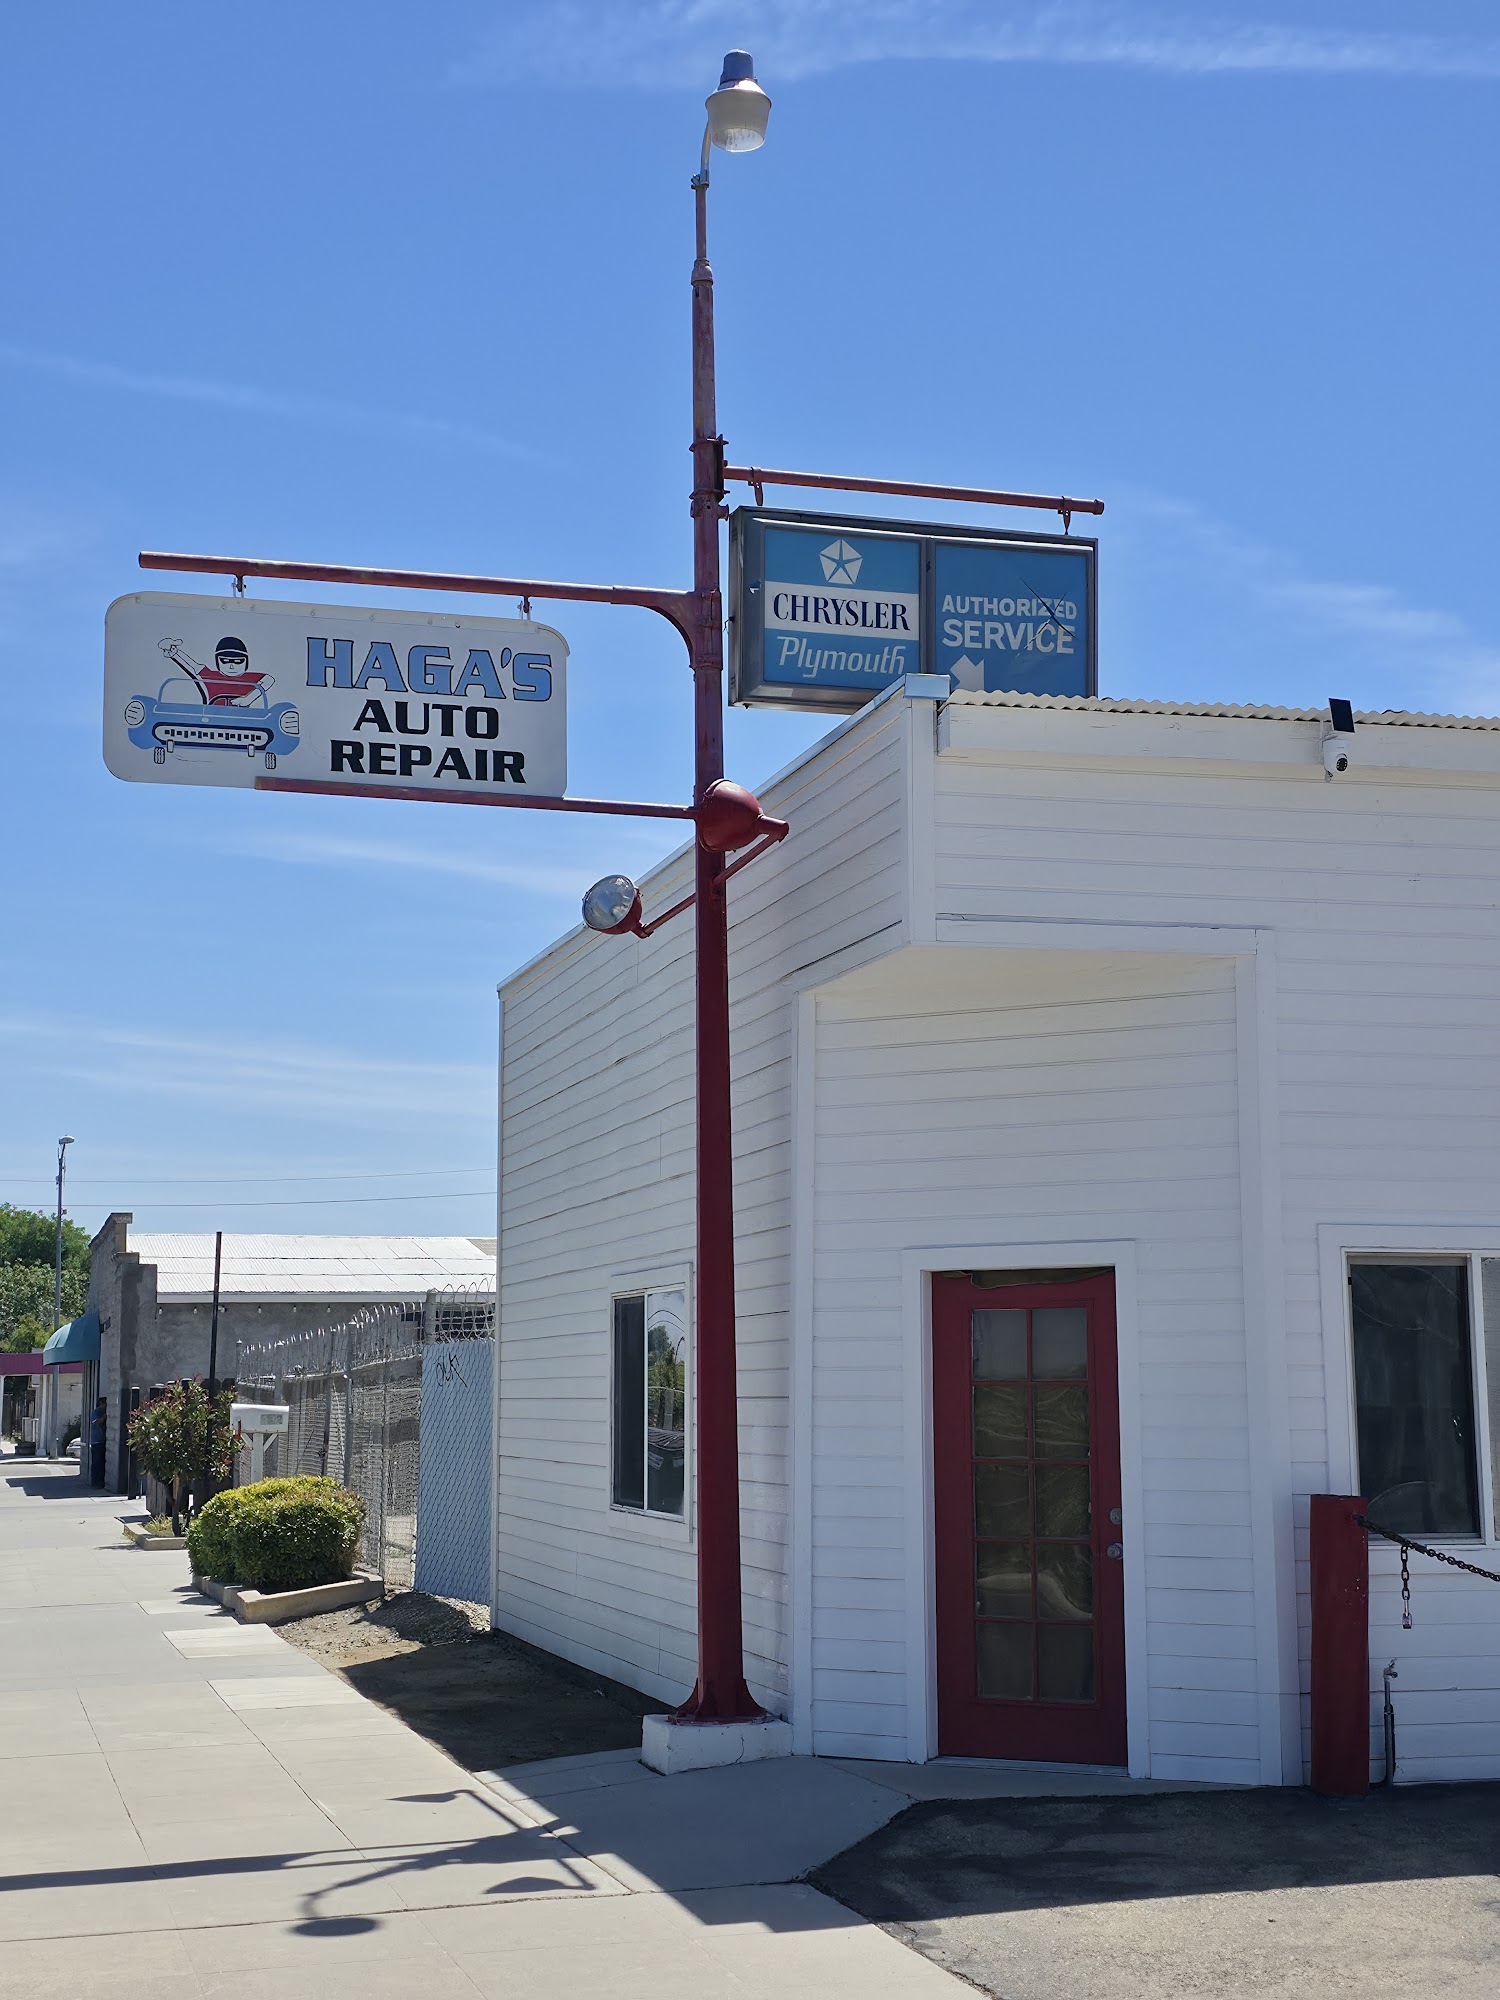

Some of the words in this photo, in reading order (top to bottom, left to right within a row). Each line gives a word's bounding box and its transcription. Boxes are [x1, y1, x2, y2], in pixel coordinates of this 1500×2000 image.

[774, 593, 910, 630] CHRYSLER
[942, 595, 1077, 620] AUTHORIZED
[942, 619, 1076, 654] SERVICE
[306, 637, 552, 701] HAGA'S
[777, 637, 906, 678] Plymouth
[353, 700, 499, 739] AUTO
[331, 740, 527, 784] REPAIR
